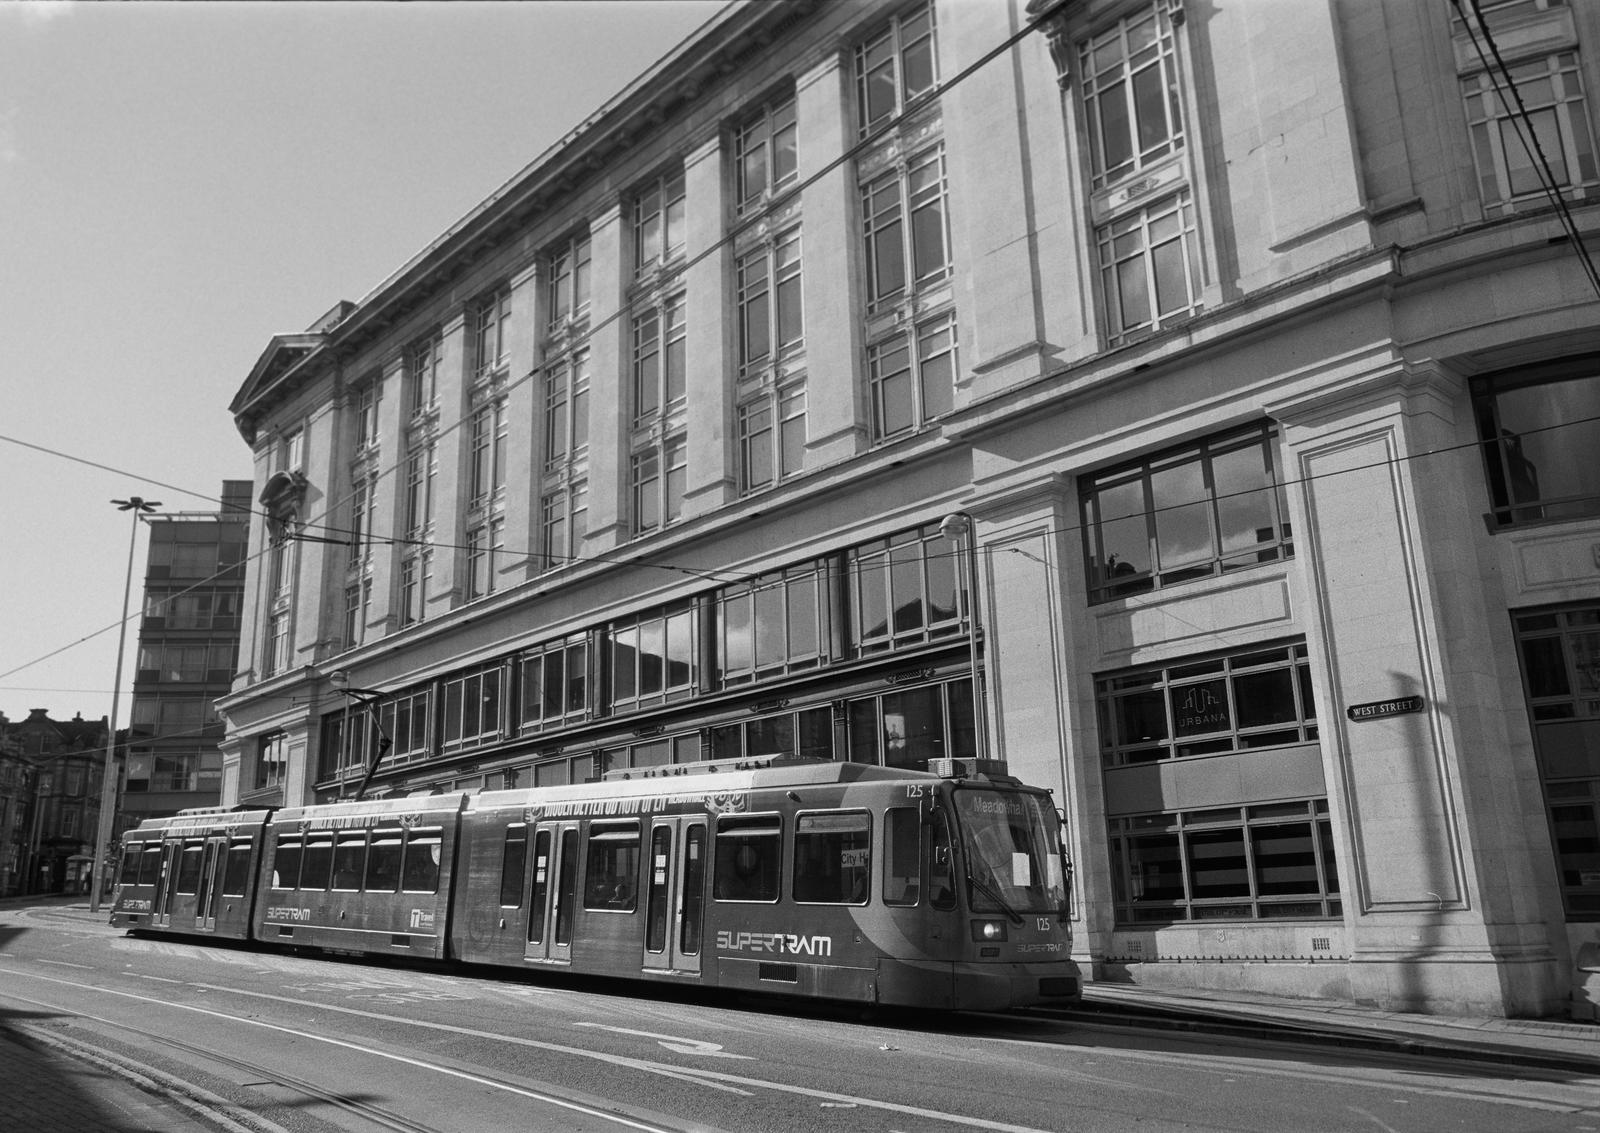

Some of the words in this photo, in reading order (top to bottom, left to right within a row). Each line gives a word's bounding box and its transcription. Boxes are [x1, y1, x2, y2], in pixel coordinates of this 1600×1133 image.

[1353, 705, 1376, 717] WEST
[1380, 700, 1413, 713] STREET
[1180, 713, 1226, 727] URBANA
[906, 784, 923, 798] 125
[841, 852, 857, 866] City
[267, 906, 311, 921] SUPERTRAM
[1036, 917, 1050, 931] 125
[716, 930, 831, 956] SUPERTRAM
[1017, 943, 1063, 953] SUPERTRA
